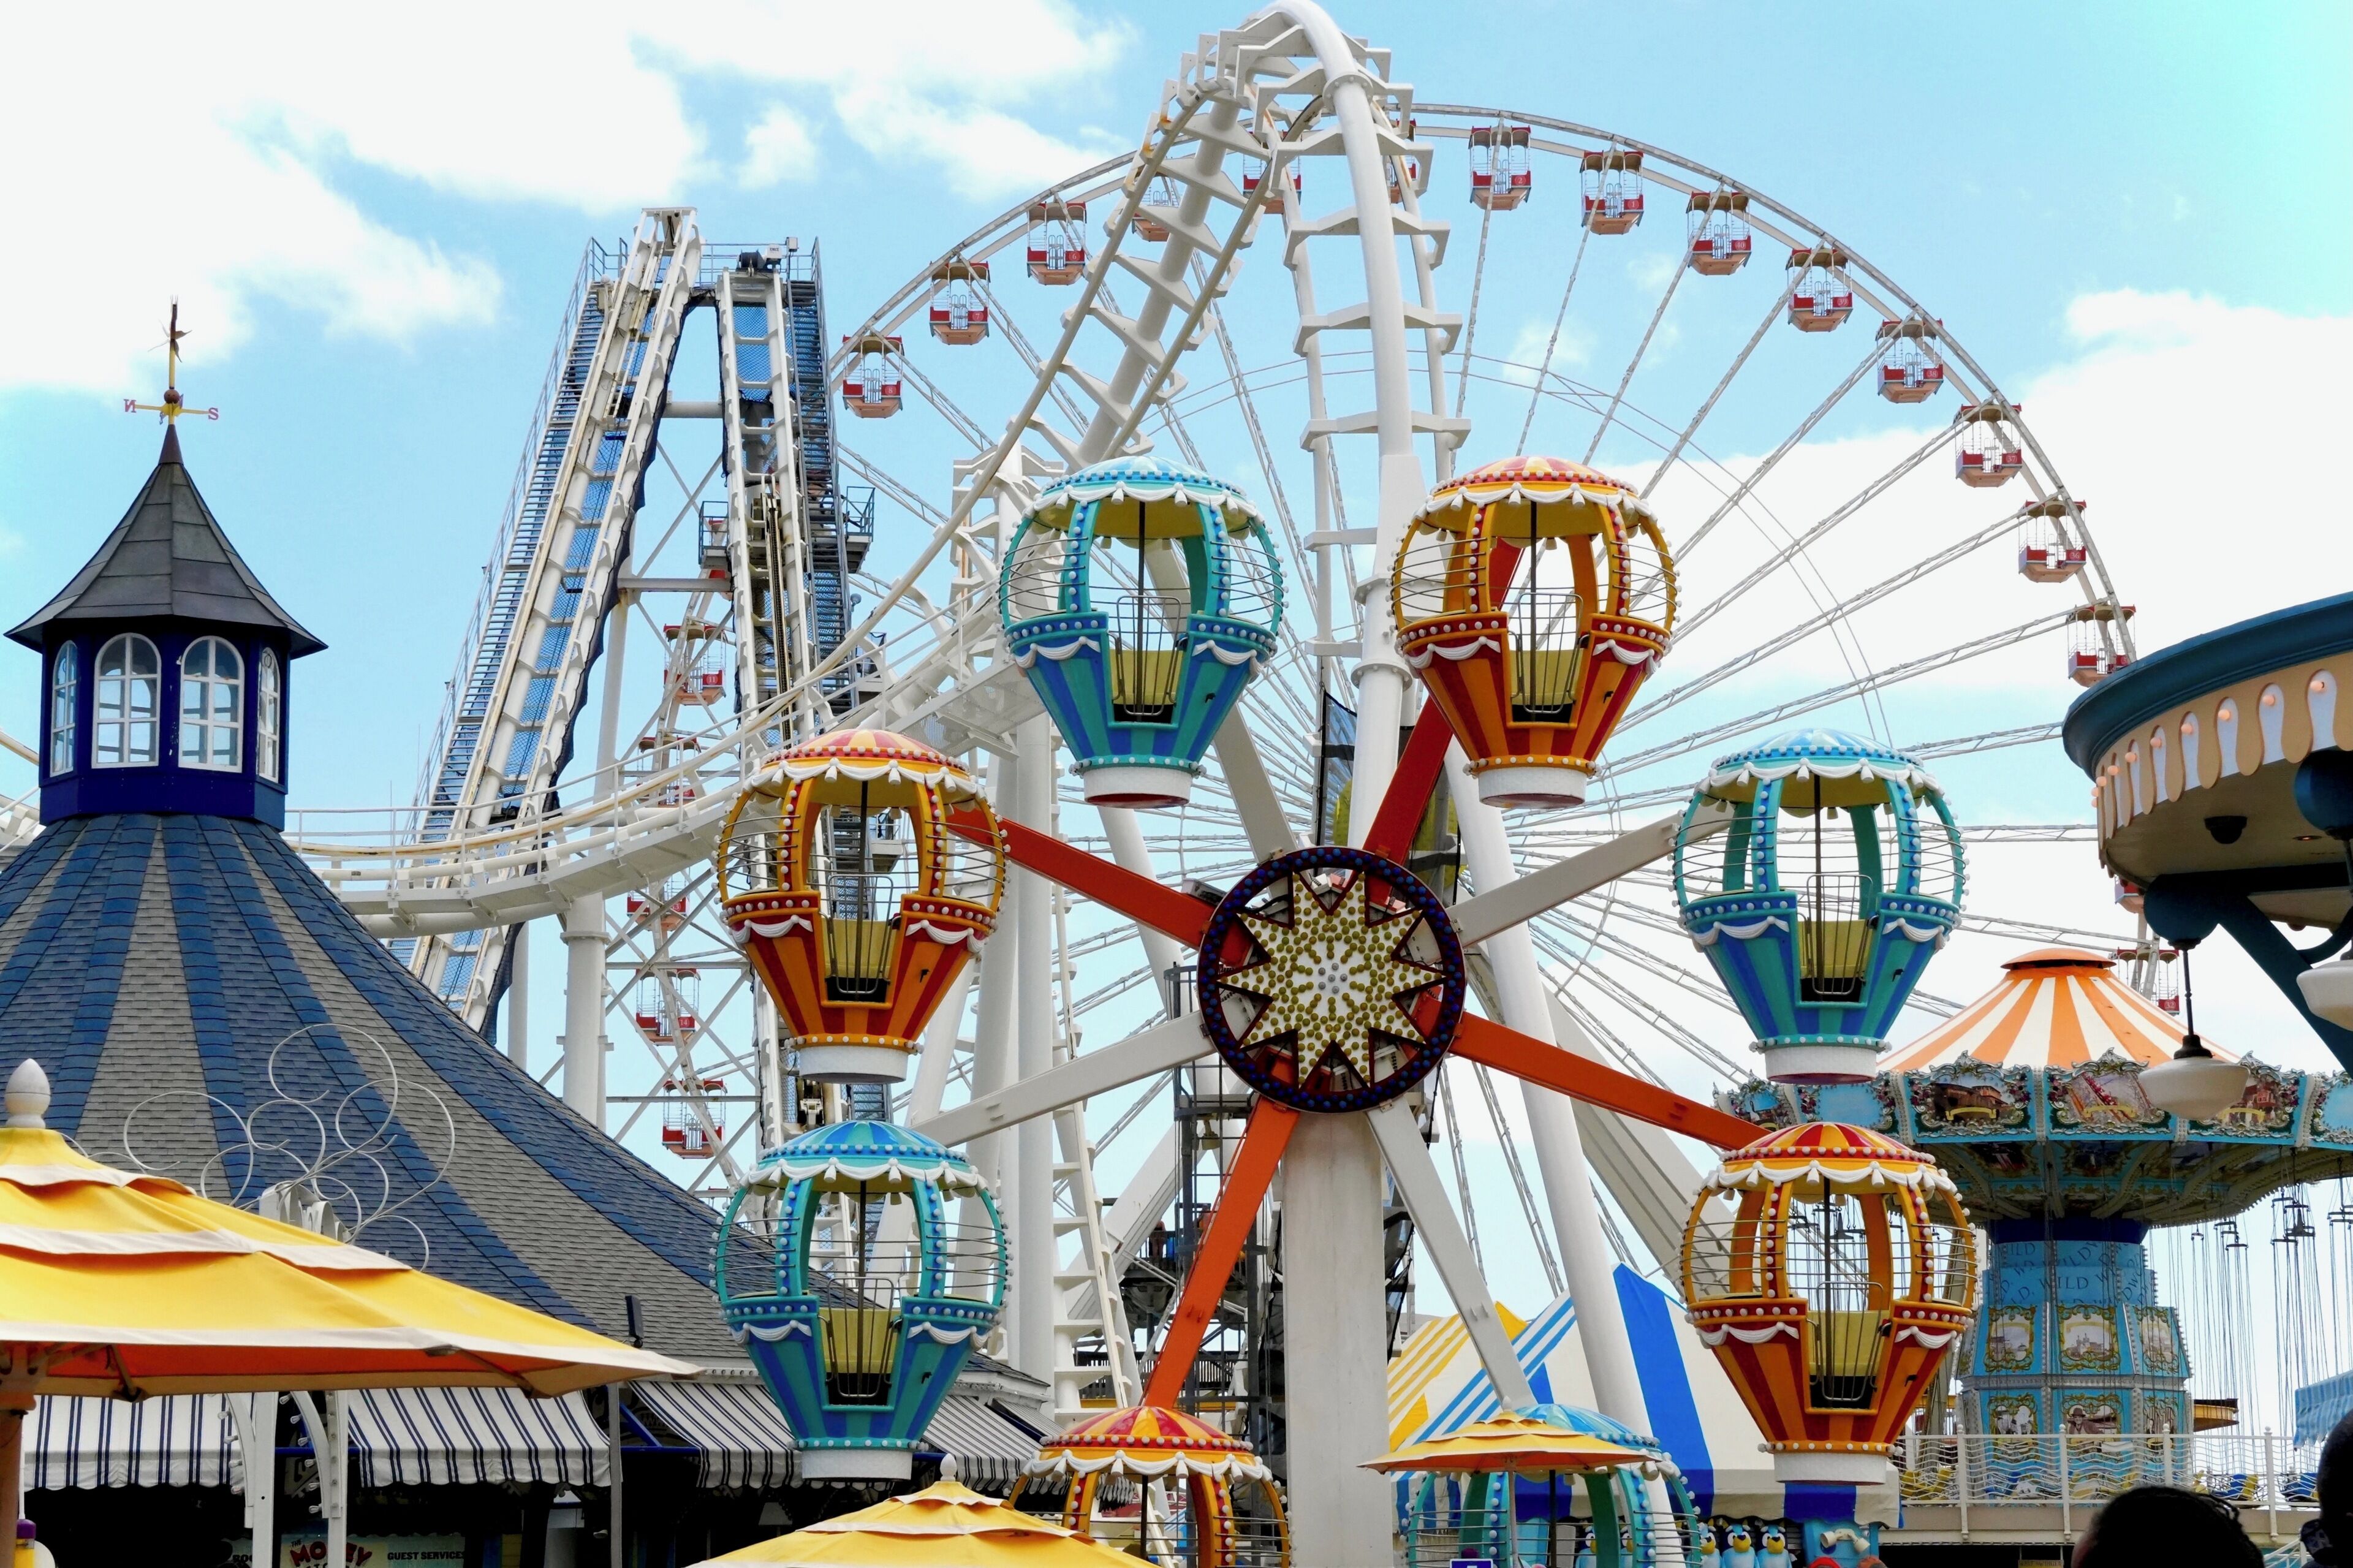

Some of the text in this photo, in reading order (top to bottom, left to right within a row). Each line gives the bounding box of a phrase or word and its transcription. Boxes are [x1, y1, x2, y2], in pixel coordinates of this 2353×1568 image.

[208, 407, 219, 420] S
[291, 1539, 301, 1547] THE
[290, 1541, 373, 1567] MOEY
